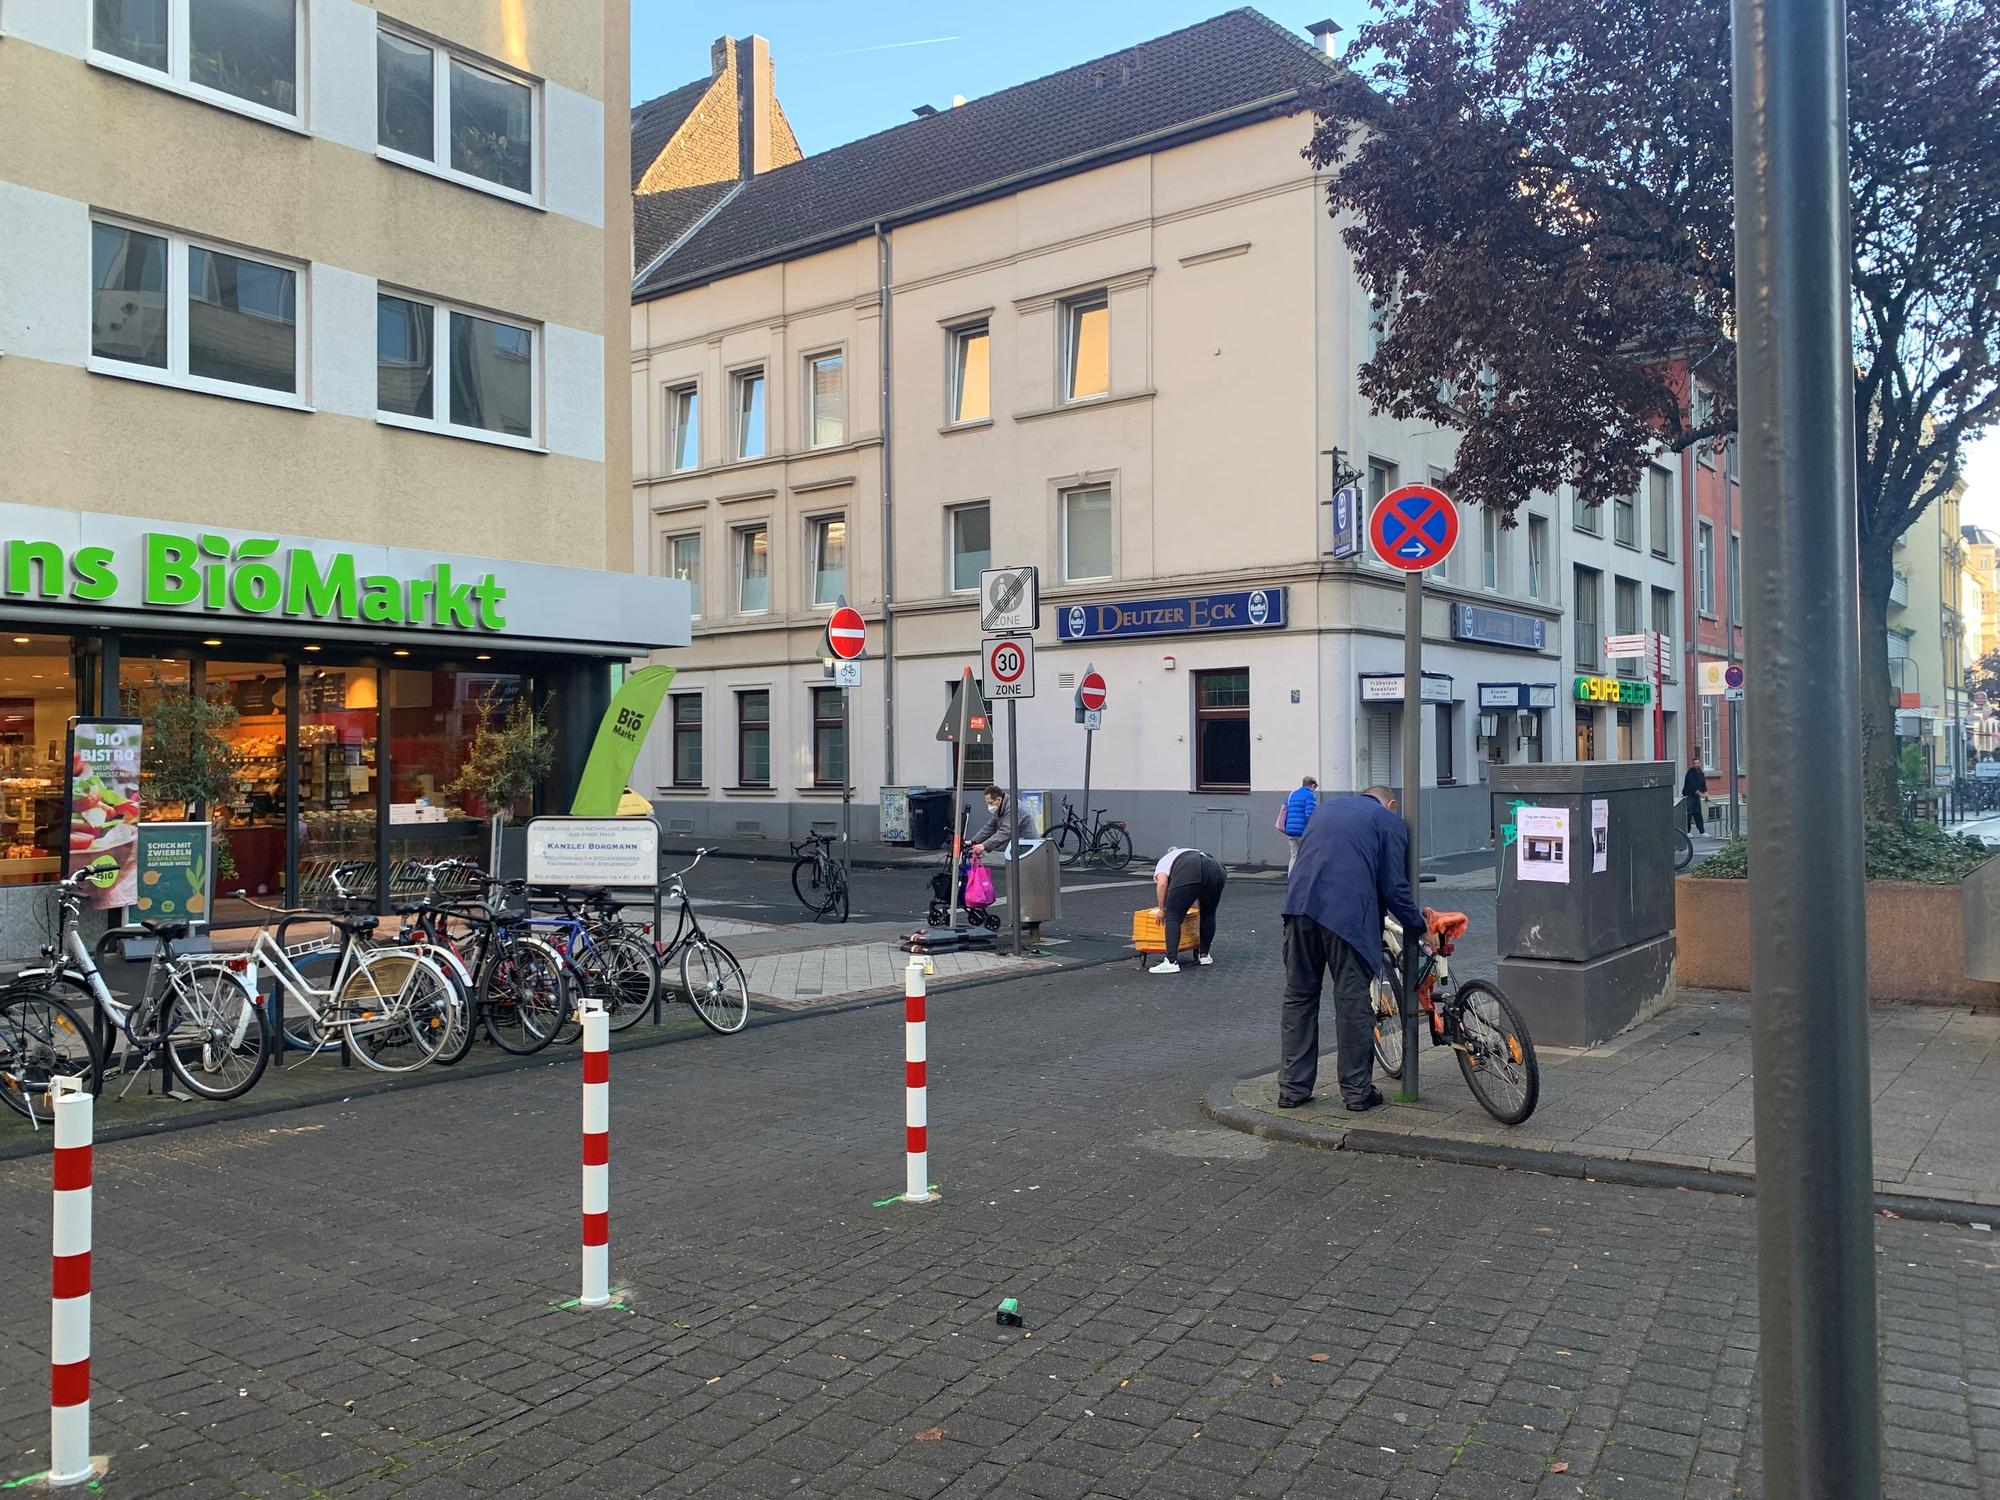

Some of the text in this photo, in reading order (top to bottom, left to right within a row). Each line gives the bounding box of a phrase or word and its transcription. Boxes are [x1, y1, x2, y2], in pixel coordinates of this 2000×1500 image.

[5, 538, 118, 600] ns
[994, 615, 1020, 626] ZONE
[1096, 599, 1236, 633] DEUTZER ECK
[998, 653, 1018, 671] 30
[996, 684, 1021, 695] ZONE
[95, 733, 123, 746] BIO
[612, 725, 636, 742] Markt
[81, 749, 135, 762] BISTRO
[147, 842, 176, 850] SCHICK
[547, 842, 638, 850] KANZLEI BORGMANN
[147, 849, 192, 857] ZWIEBELN
